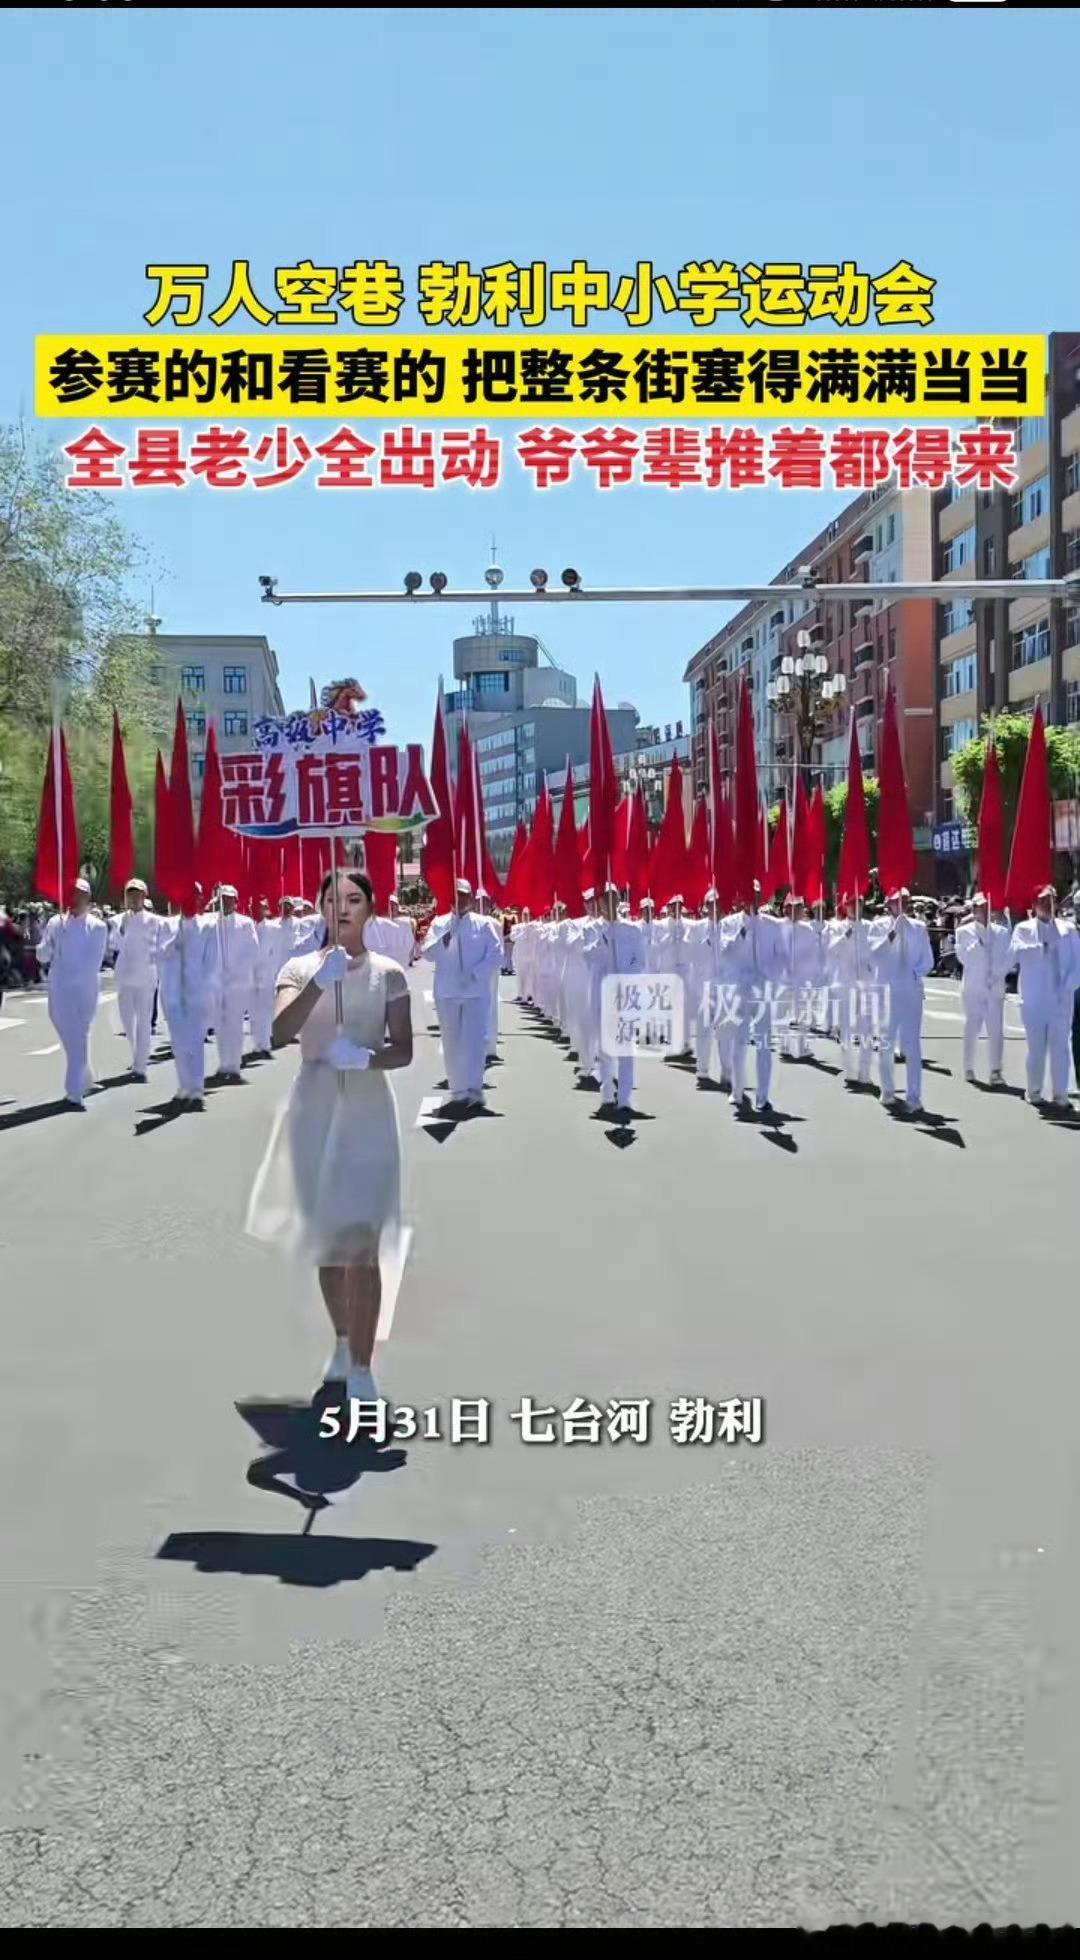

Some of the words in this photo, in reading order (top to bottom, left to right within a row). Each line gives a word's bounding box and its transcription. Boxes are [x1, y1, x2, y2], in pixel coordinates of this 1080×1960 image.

[253, 708, 387, 747] 高级中学
[221, 744, 440, 825] 彩旗队
